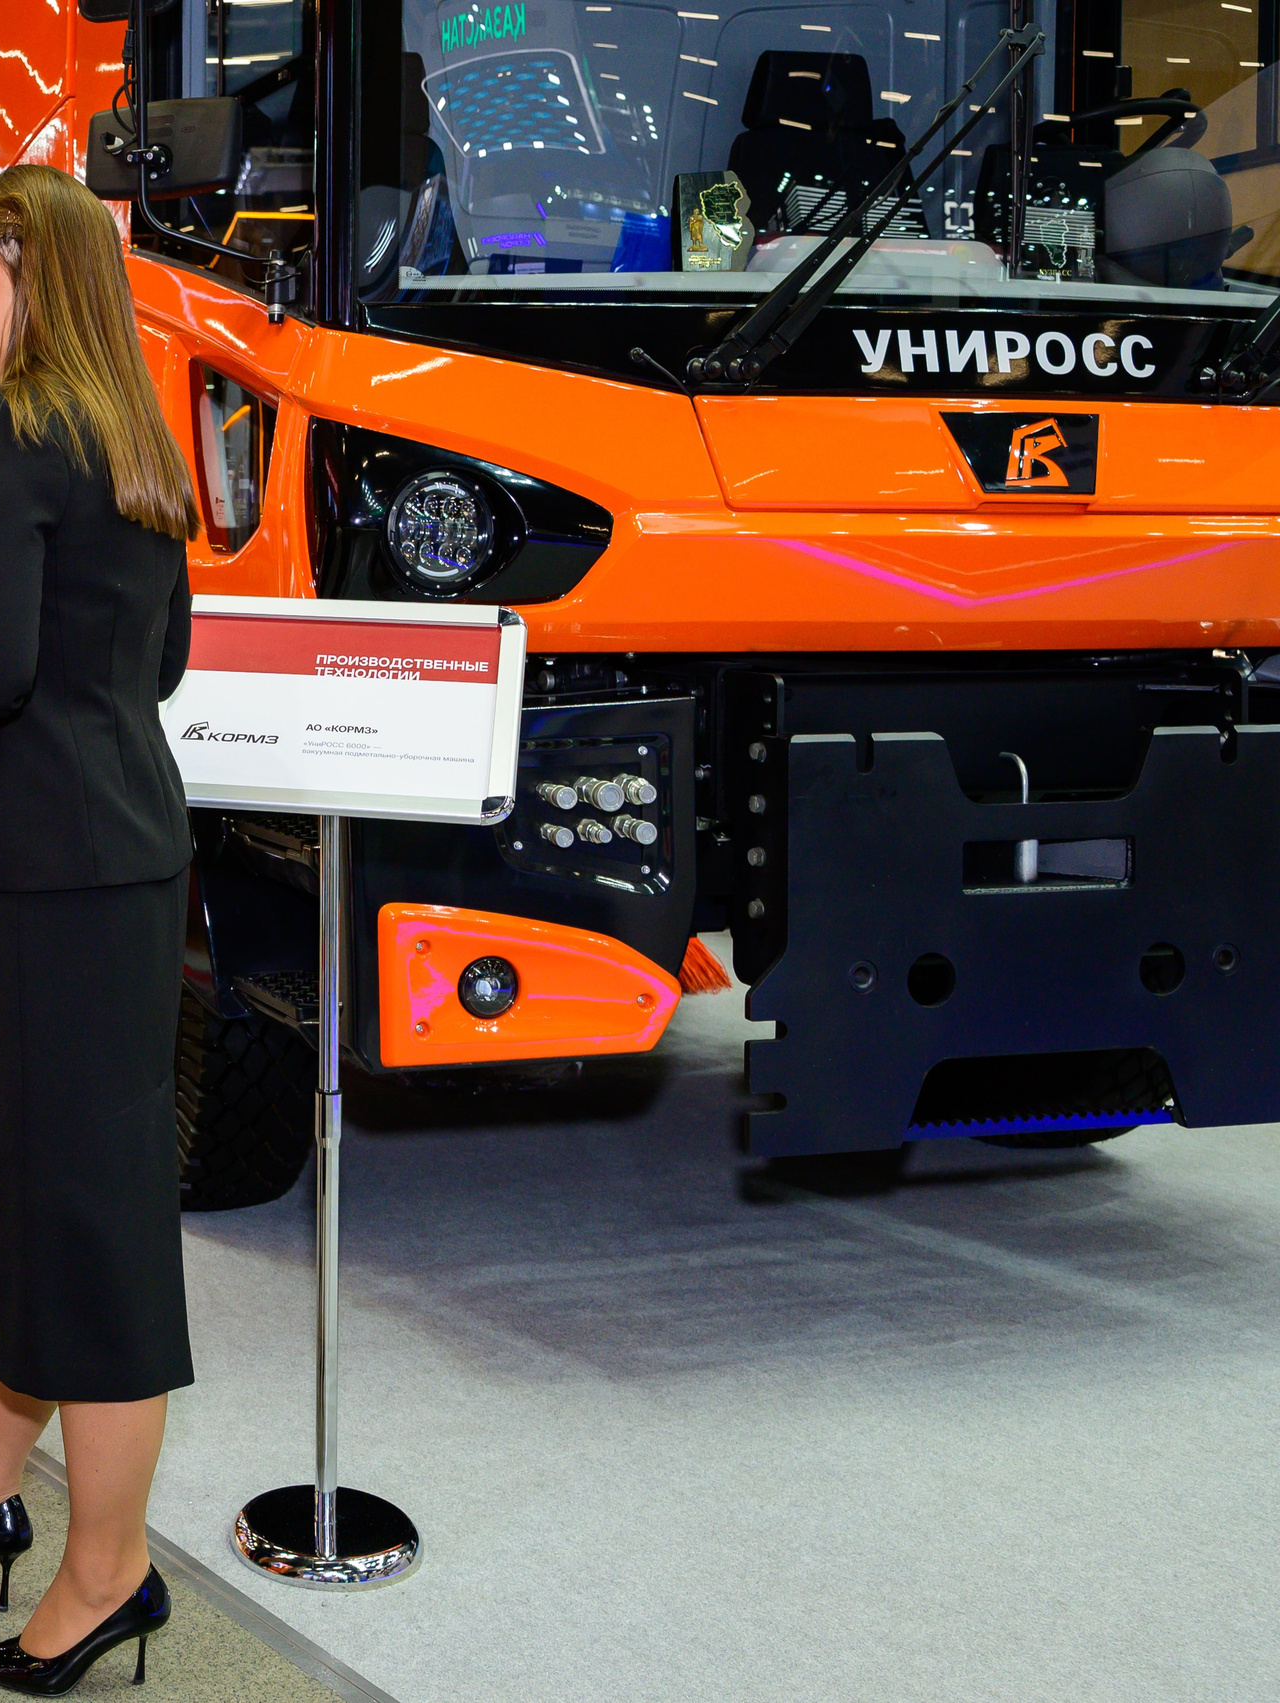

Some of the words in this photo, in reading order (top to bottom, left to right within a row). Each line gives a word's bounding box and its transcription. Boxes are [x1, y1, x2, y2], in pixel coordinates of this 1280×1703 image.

[852, 329, 1156, 378] УНИРОСС
[315, 654, 489, 672] ПРОИЗВОДСТВЕННЫЕ
[315, 666, 421, 681] ТЕХНОЛОГИИ
[305, 723, 322, 732] АО
[324, 725, 379, 735] «КОРМЗ»
[207, 732, 279, 745] КОРМЗ
[301, 749, 343, 757] вакуумная
[344, 750, 442, 762] подметально-уборочная
